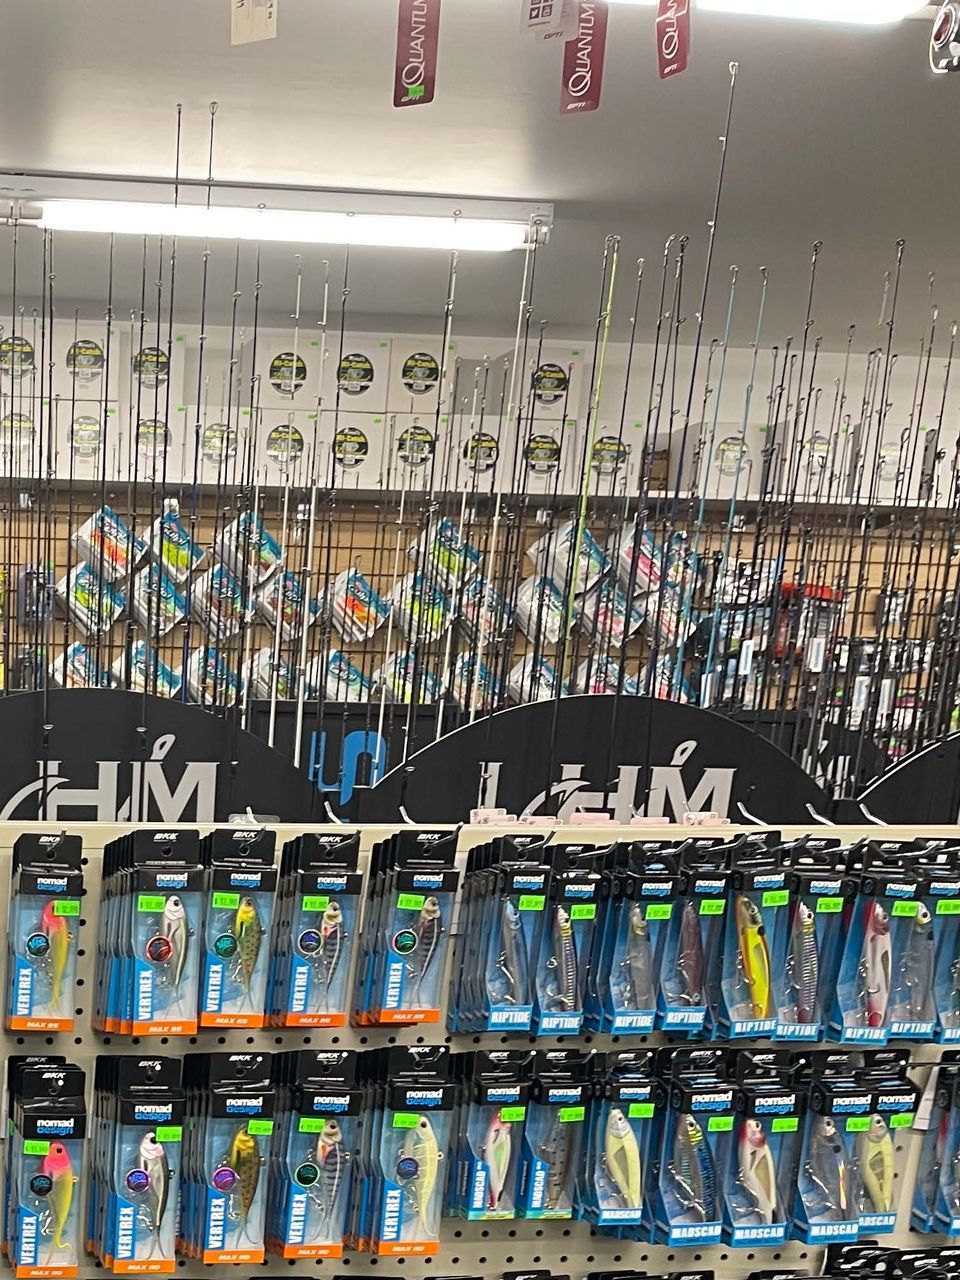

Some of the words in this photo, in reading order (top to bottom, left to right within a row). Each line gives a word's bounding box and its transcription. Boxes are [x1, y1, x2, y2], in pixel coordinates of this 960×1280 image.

[293, 966, 309, 1011] VERTREX
[386, 962, 403, 1008] VERTREX
[17, 968, 32, 1016] VERTREX
[138, 970, 153, 1020] VERTREX
[491, 1012, 530, 1023] RIPTIDE
[667, 1012, 705, 1023] RIPTIDE
[542, 1018, 582, 1029] RIPTIDE
[735, 1021, 776, 1032] RIPTIDE
[777, 1025, 817, 1035] RIPTIDE
[845, 1029, 886, 1039] RIPTIDE
[692, 1091, 732, 1103] nomad
[135, 1104, 172, 1113] nomad
[691, 1101, 731, 1111] design
[135, 1111, 171, 1122] design
[383, 1189, 401, 1240] VERTREX
[118, 1207, 134, 1258] VERTREX
[672, 1224, 721, 1237] MADSCAD
[735, 1227, 784, 1239] MADSCAD
